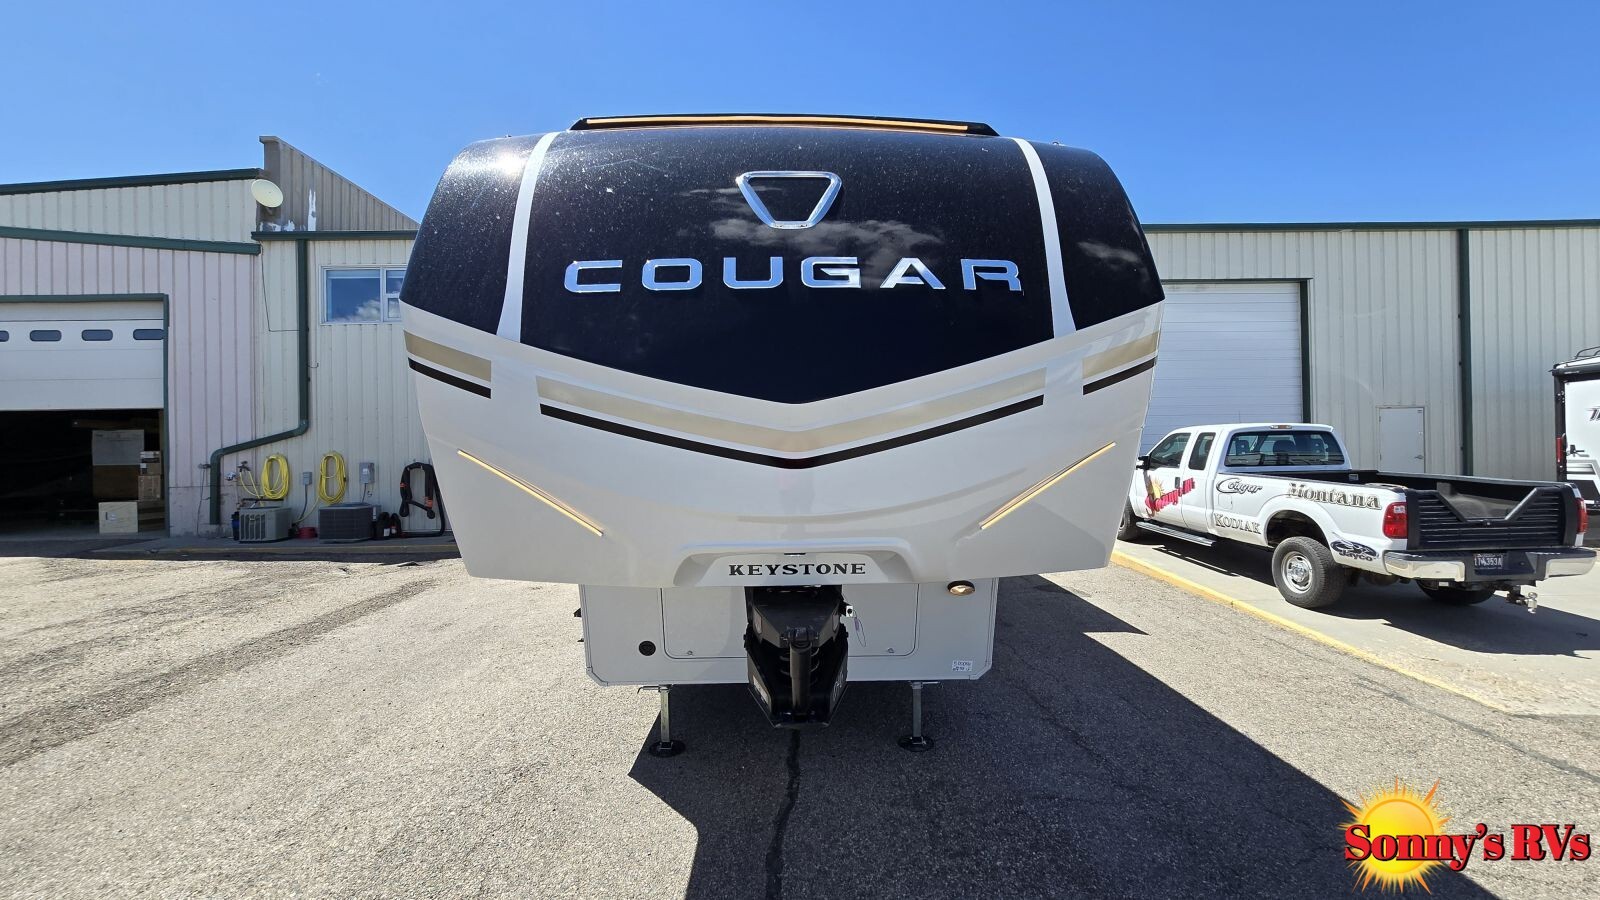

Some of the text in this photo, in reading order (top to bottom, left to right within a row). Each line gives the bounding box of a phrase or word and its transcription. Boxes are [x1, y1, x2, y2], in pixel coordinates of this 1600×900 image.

[564, 256, 1022, 293] COUGAR
[1216, 478, 1263, 494] Cougar
[1287, 482, 1382, 510] Montana
[1214, 513, 1261, 535] KODIAK
[1338, 551, 1374, 562] Jayco
[728, 563, 866, 576] KEYSTONE
